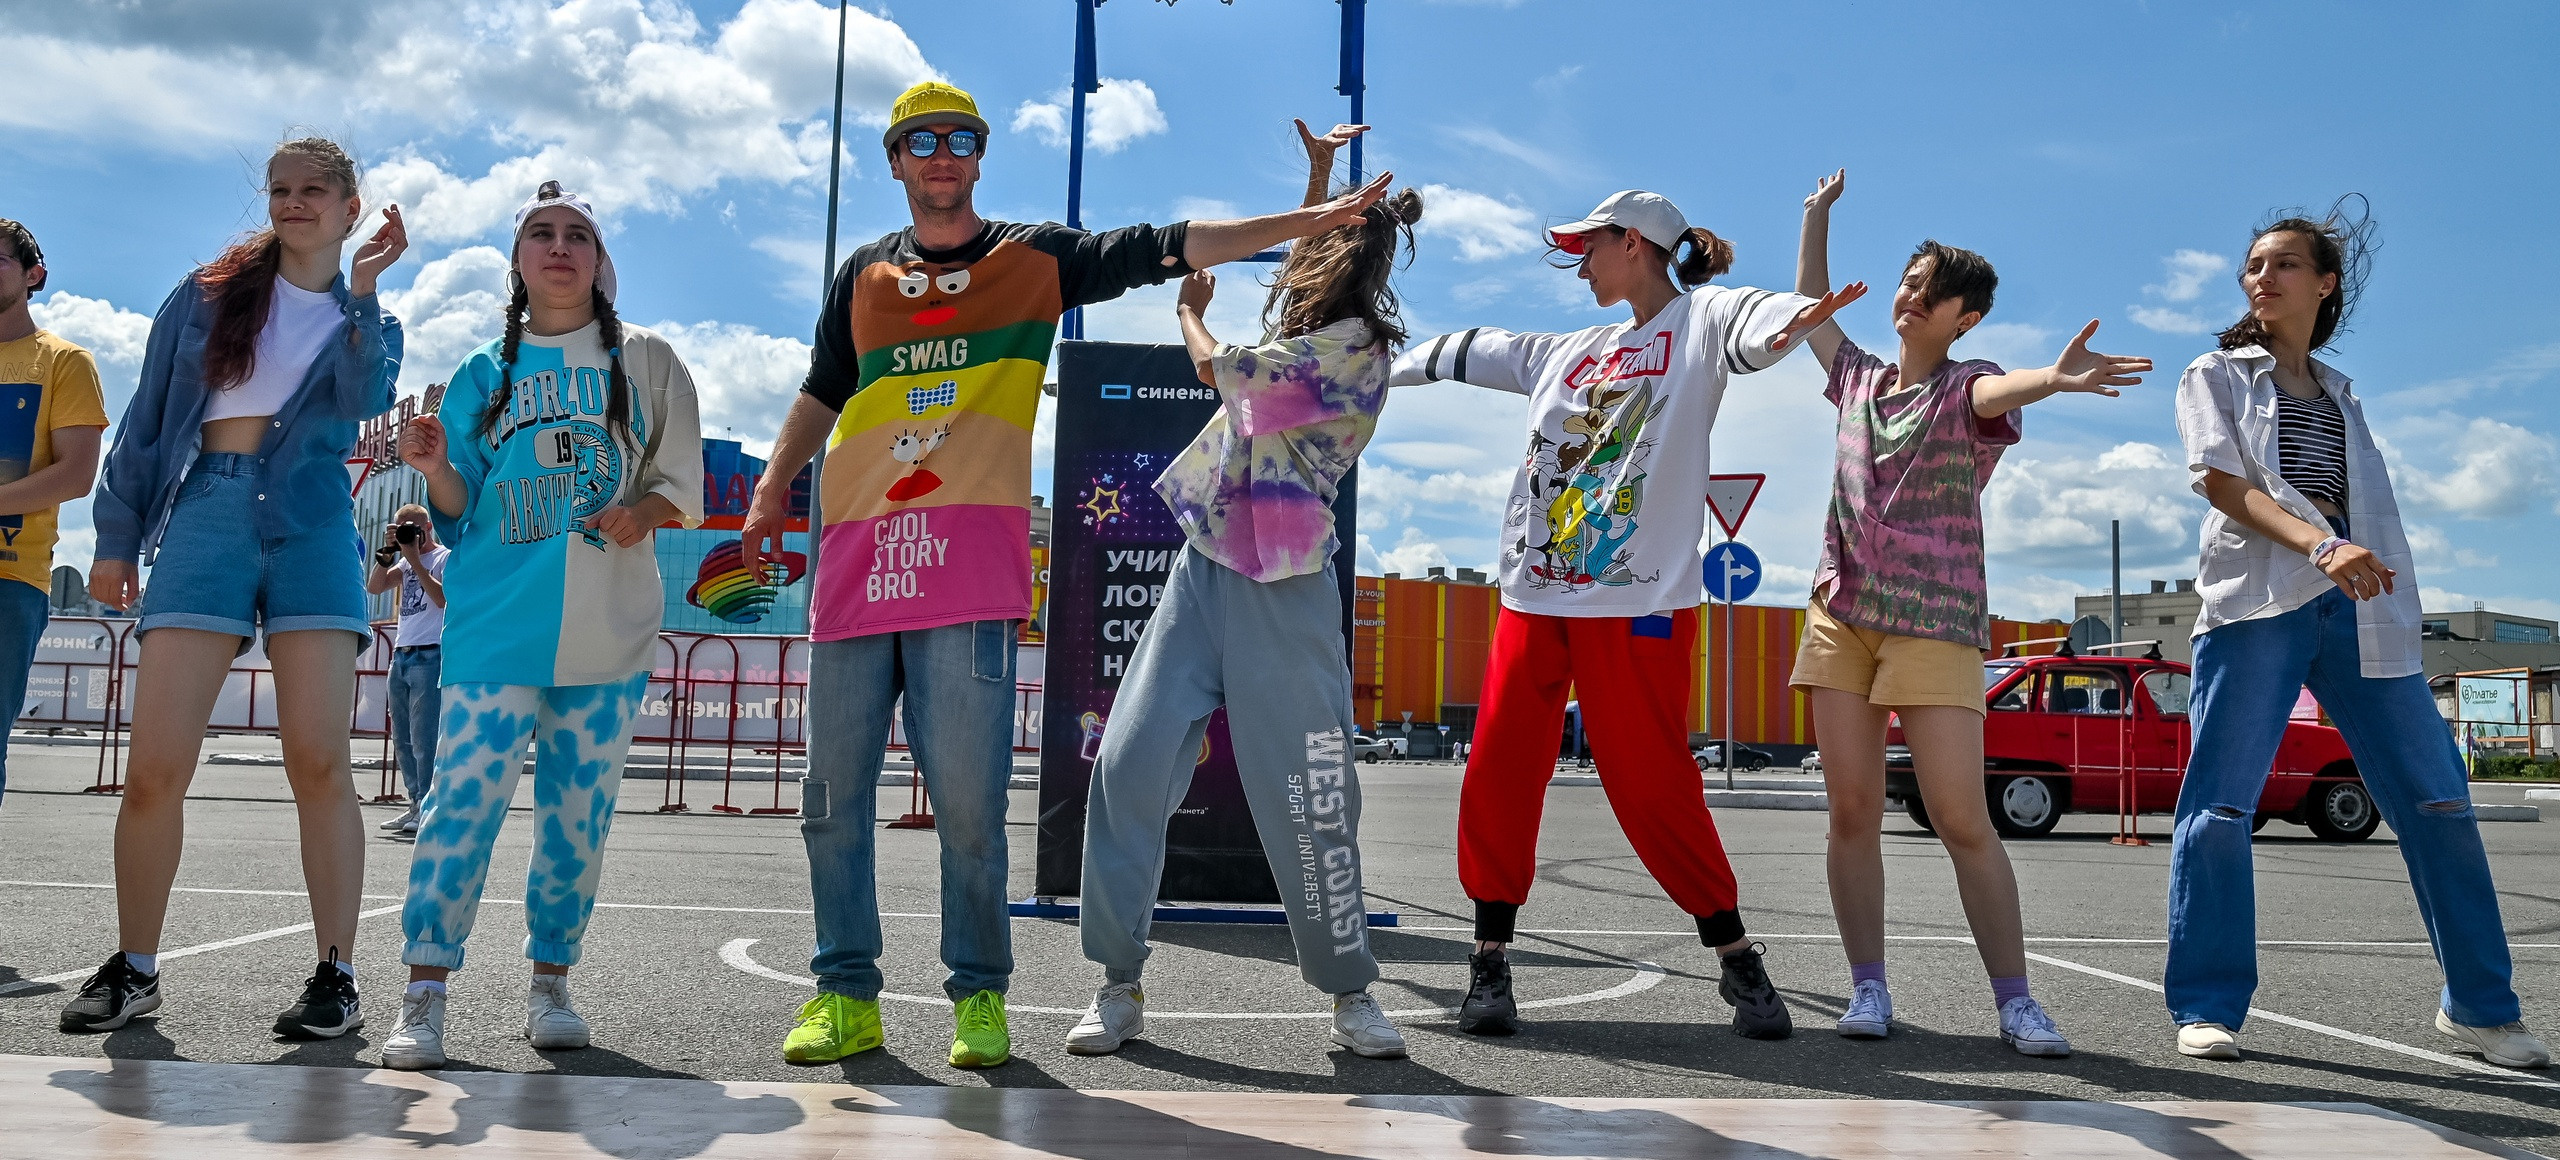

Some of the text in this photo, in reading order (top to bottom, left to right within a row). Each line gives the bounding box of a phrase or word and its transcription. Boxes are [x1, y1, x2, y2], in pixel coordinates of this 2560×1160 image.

[891, 337, 968, 373] SWAG
[1136, 386, 1215, 400] синема
[554, 431, 573, 464] 19
[1616, 487, 1633, 513] B
[874, 513, 932, 546] COOL
[871, 537, 949, 573] STORY
[866, 571, 926, 603] BRO.
[1103, 619, 1148, 642] СК
[1173, 807, 1209, 815] ланета"
[1305, 726, 1366, 957] WEST COAST
